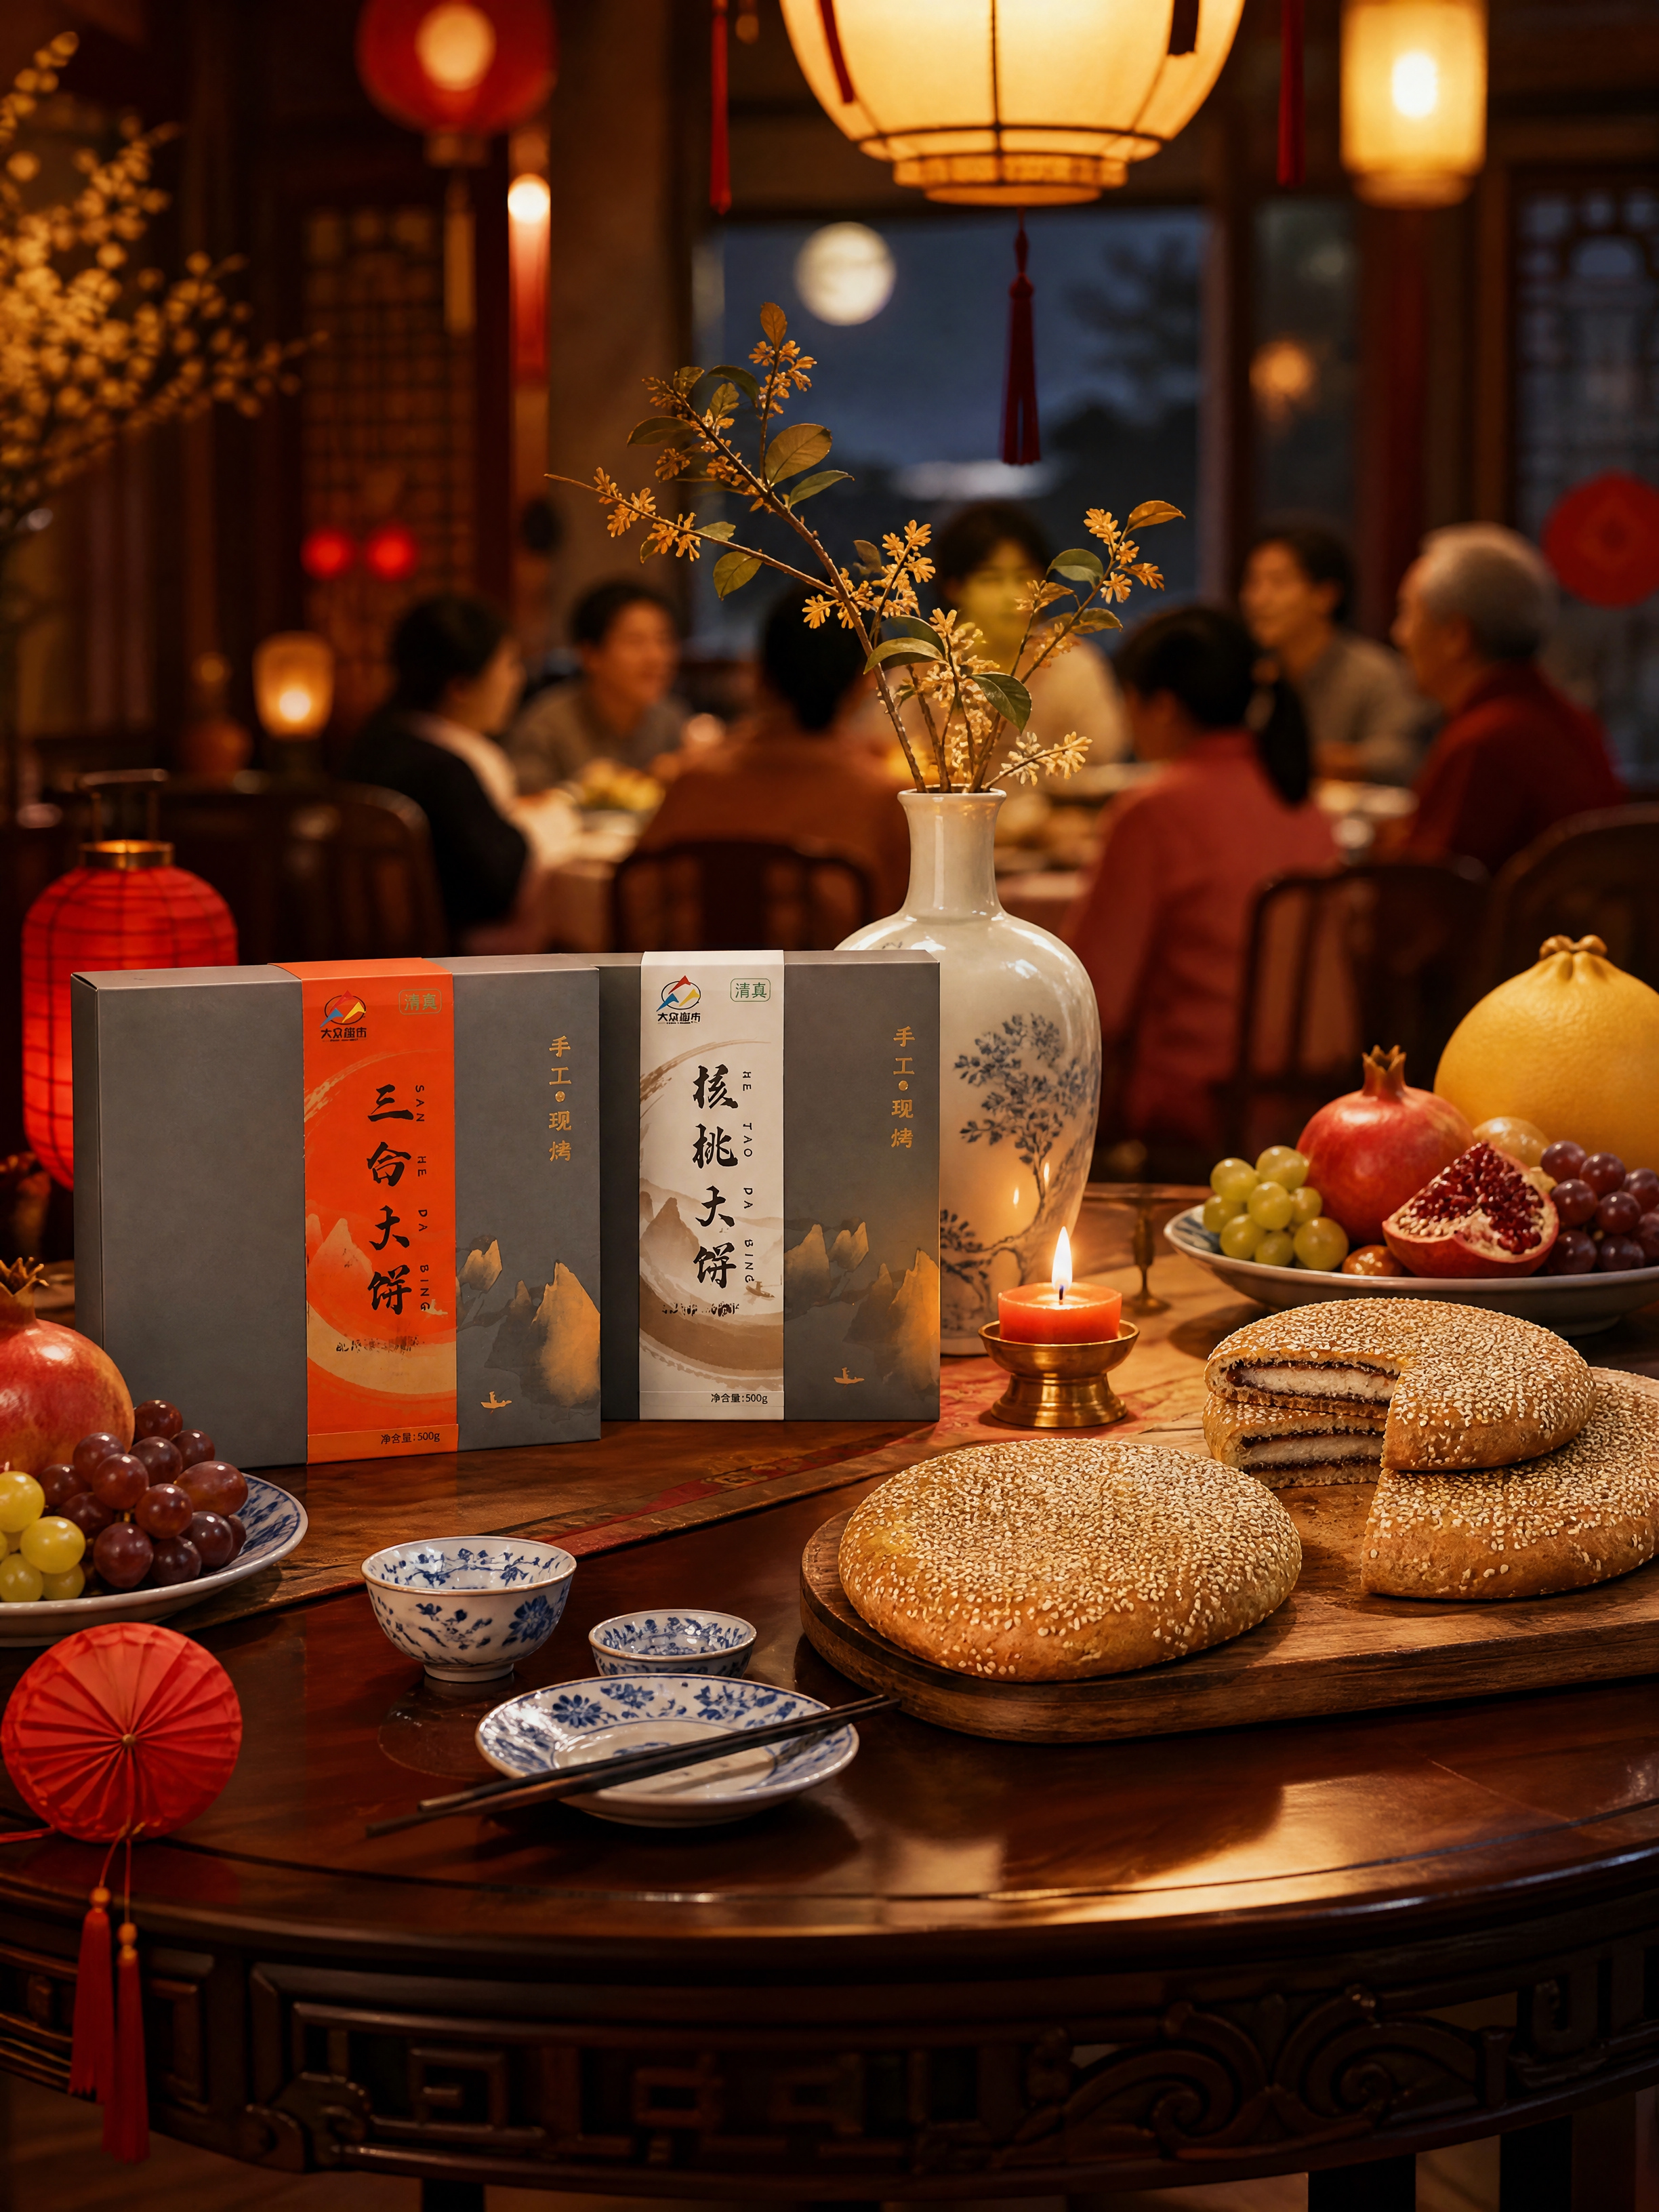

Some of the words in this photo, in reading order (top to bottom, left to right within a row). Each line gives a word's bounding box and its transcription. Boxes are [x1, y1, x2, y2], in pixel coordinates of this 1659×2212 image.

[405, 993, 437, 1011] 清真
[735, 982, 767, 998] 清真
[743, 1071, 752, 1092] HE
[415, 1085, 425, 1122] SAN
[743, 1122, 753, 1158] TAO
[417, 1155, 427, 1177] HE
[693, 1064, 739, 1289] 核桃大饼
[367, 1084, 413, 1315] 三合大饼
[743, 1187, 754, 1209] DA
[418, 1209, 428, 1232] DA
[744, 1239, 755, 1284] BING
[419, 1264, 430, 1312] BING
